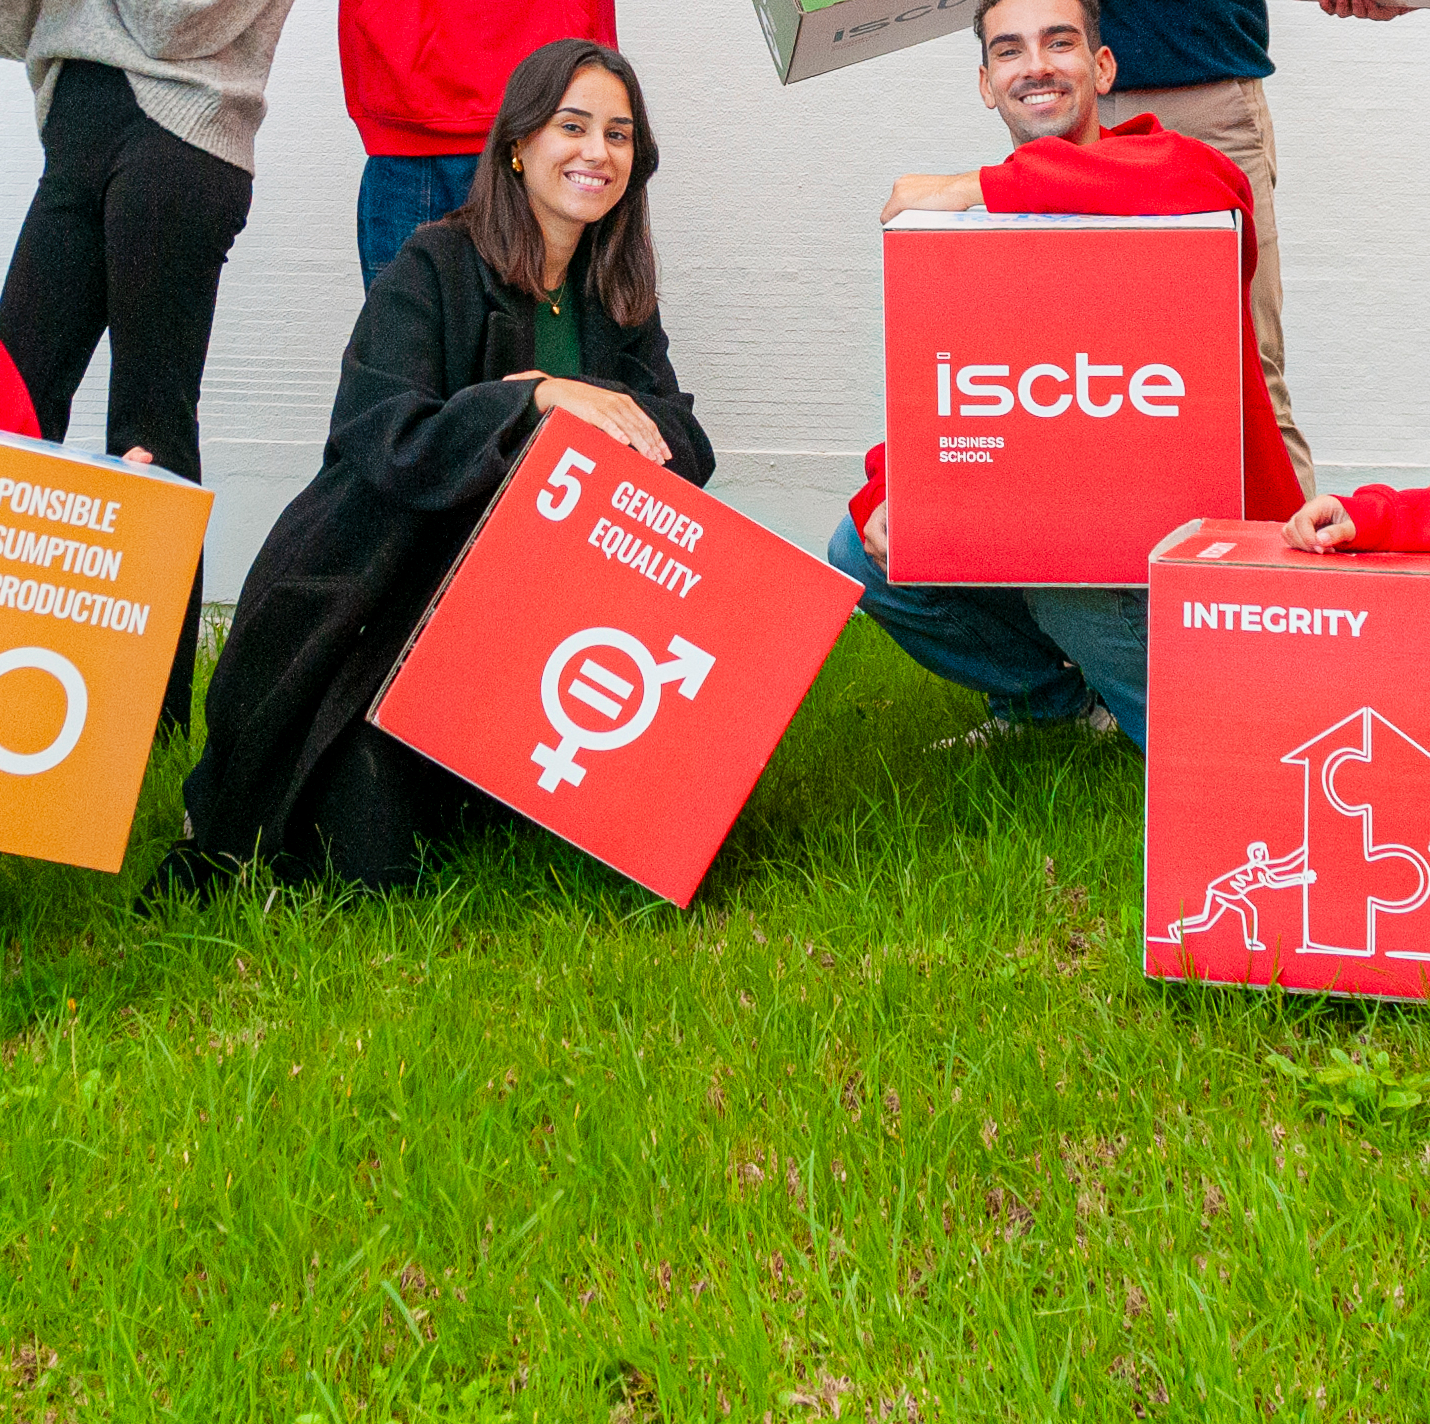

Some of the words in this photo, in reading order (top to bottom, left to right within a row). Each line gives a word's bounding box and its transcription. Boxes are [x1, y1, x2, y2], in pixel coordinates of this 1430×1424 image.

[936, 352, 1186, 418] iscte
[939, 436, 1004, 449] BUSINESS
[939, 451, 993, 463] SCHOOL
[536, 447, 596, 522] 5
[611, 480, 704, 553] GENDER
[587, 517, 702, 598] EQUALITY
[1182, 601, 1369, 637] INTEGRITY
